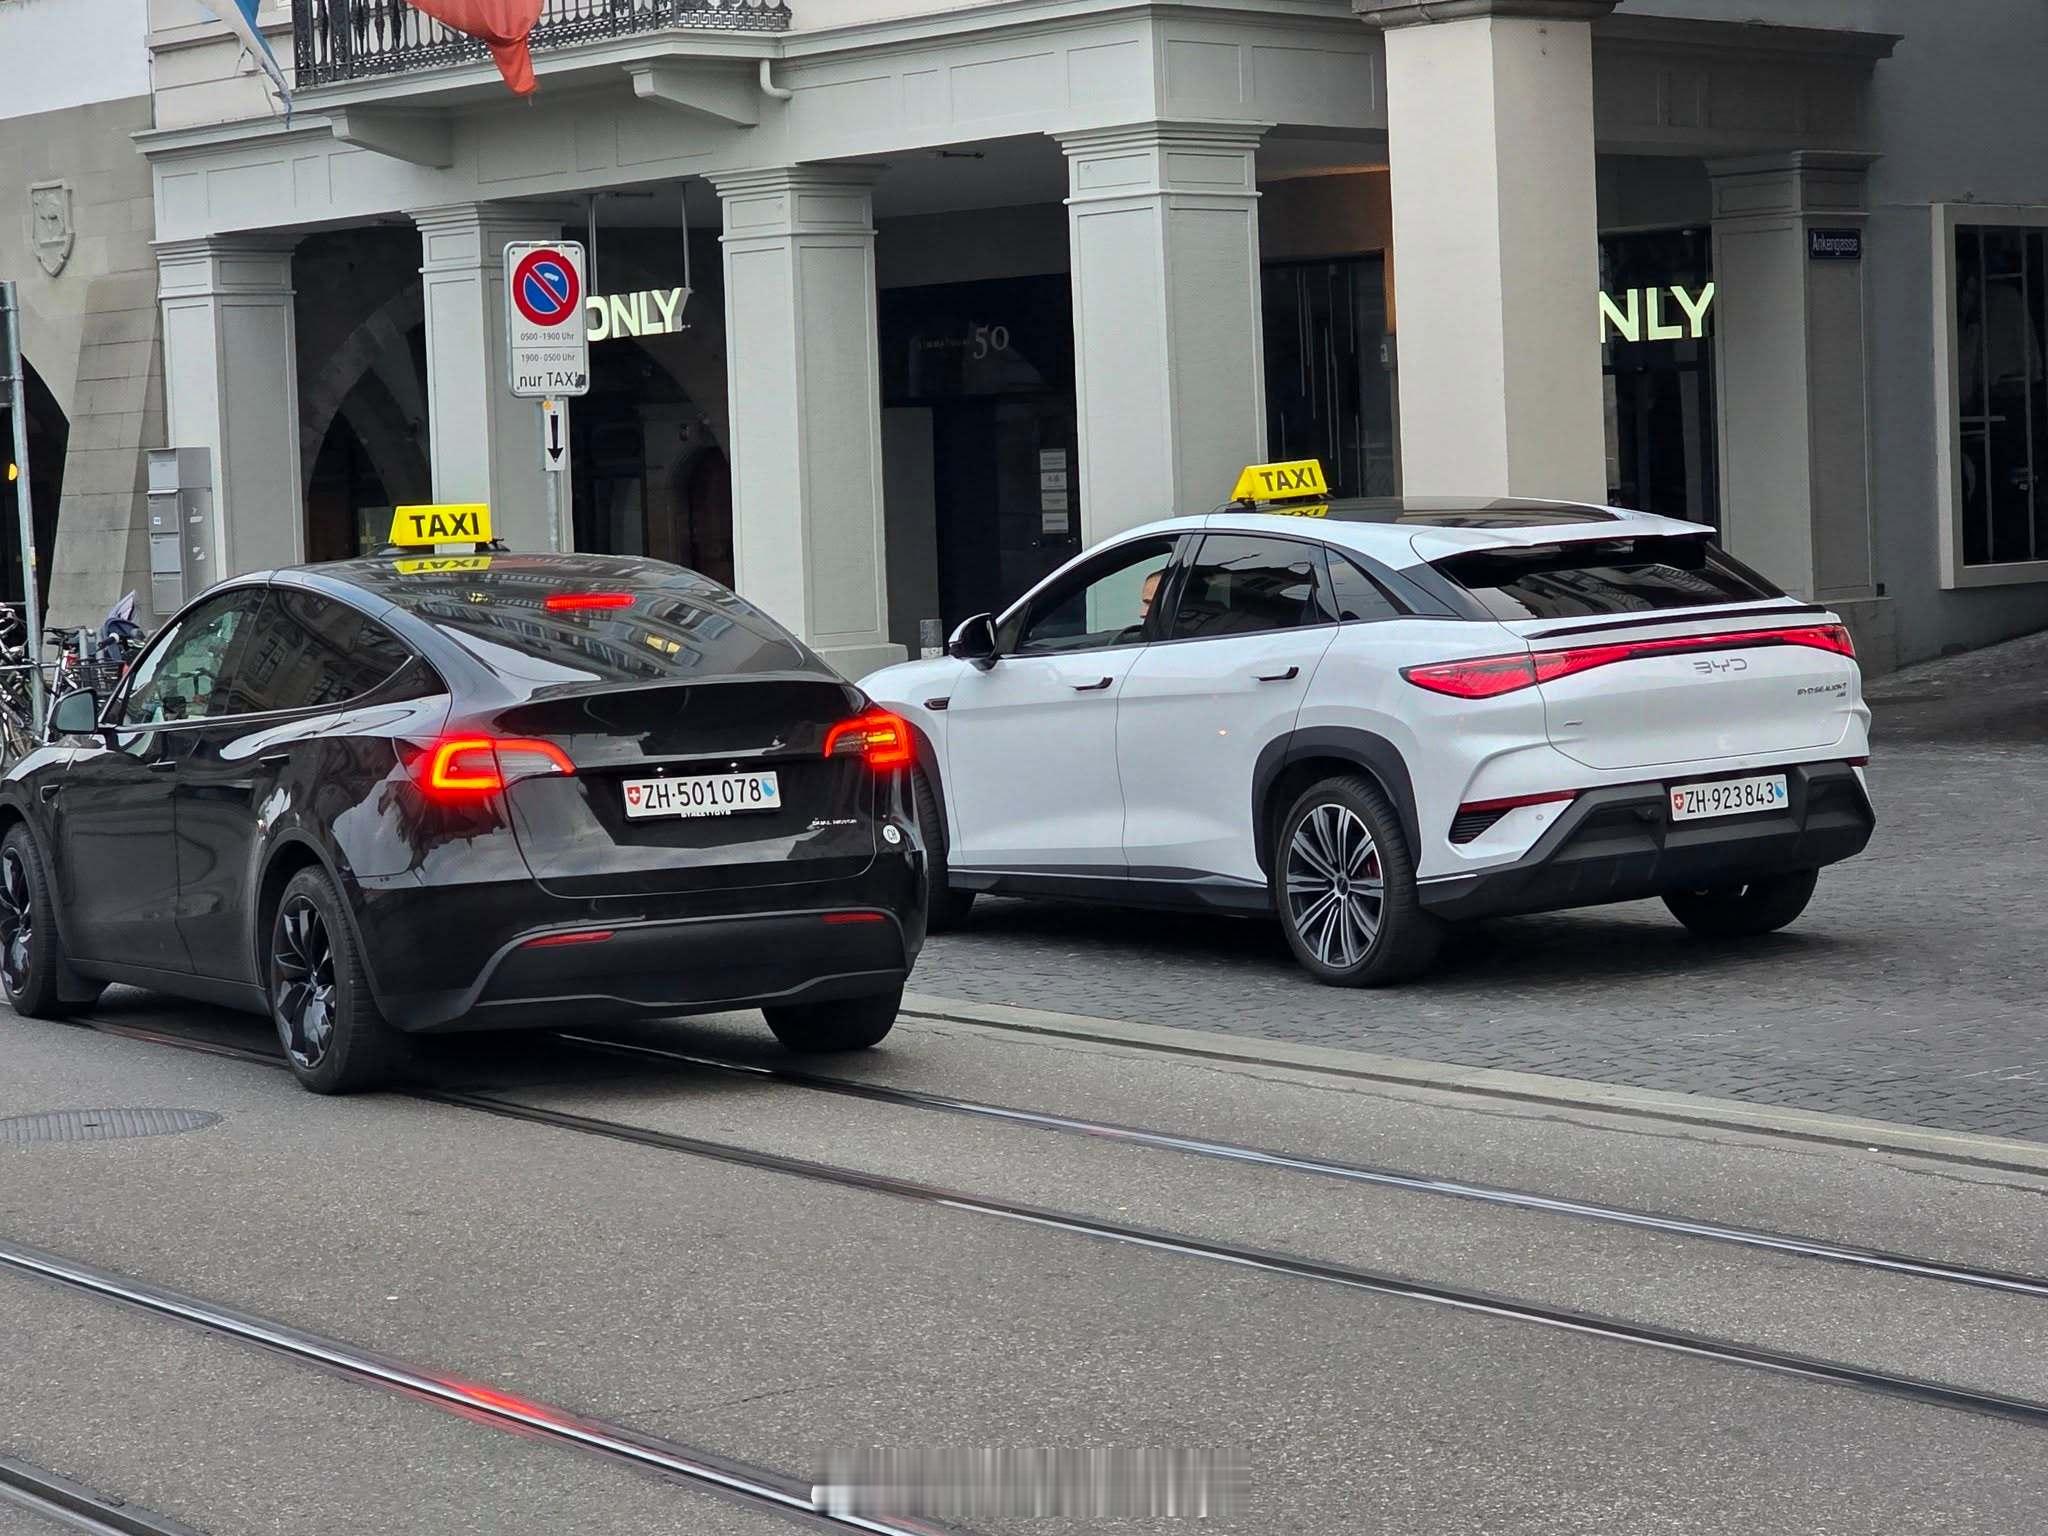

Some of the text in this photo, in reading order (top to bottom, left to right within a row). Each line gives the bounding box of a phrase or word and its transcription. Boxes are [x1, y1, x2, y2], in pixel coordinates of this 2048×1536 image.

[1812, 232, 1857, 256] Ankengasse
[1598, 282, 1715, 344] NLY
[562, 332, 575, 340] Uhr
[974, 325, 1010, 360] 50
[521, 353, 539, 362] 1900
[543, 353, 561, 362] 0500
[562, 353, 576, 361] Uhr
[520, 375, 543, 387] nur
[1258, 466, 1318, 492] TAXI
[409, 512, 480, 538] TAXI
[1692, 657, 1748, 674] BYD
